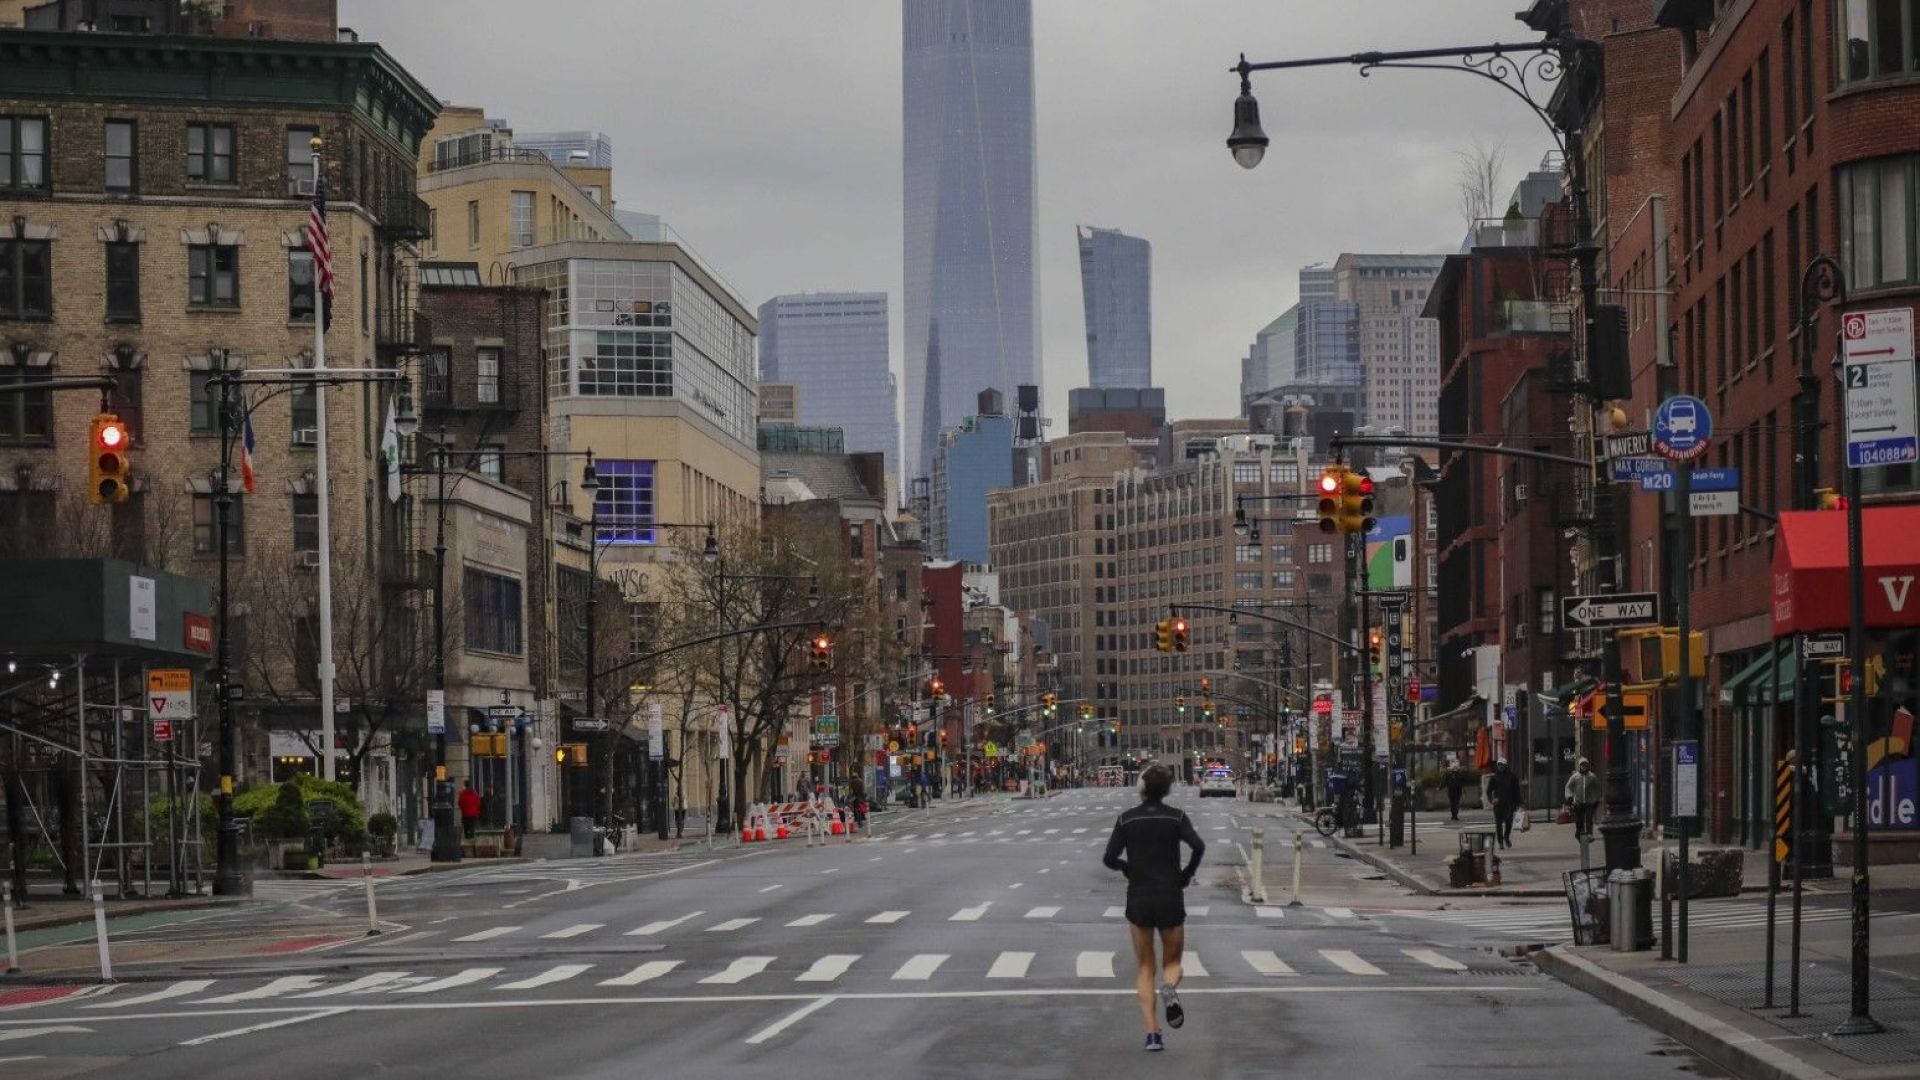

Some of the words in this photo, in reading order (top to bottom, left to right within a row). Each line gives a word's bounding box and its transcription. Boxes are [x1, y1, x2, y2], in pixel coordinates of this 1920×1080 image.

[1851, 365, 1863, 387] 2
[1609, 434, 1647, 458] WAVERLY
[1668, 440, 1707, 459] STANDING
[1615, 460, 1632, 472] MAX
[1635, 460, 1665, 472] GORDON
[1643, 473, 1672, 489] M20
[1692, 472, 1708, 480] South
[1709, 471, 1725, 481] Ferry
[1878, 576, 1915, 612] V
[1578, 605, 1605, 618] ONE
[1617, 603, 1647, 617] WAY
[1823, 642, 1840, 651] WAY
